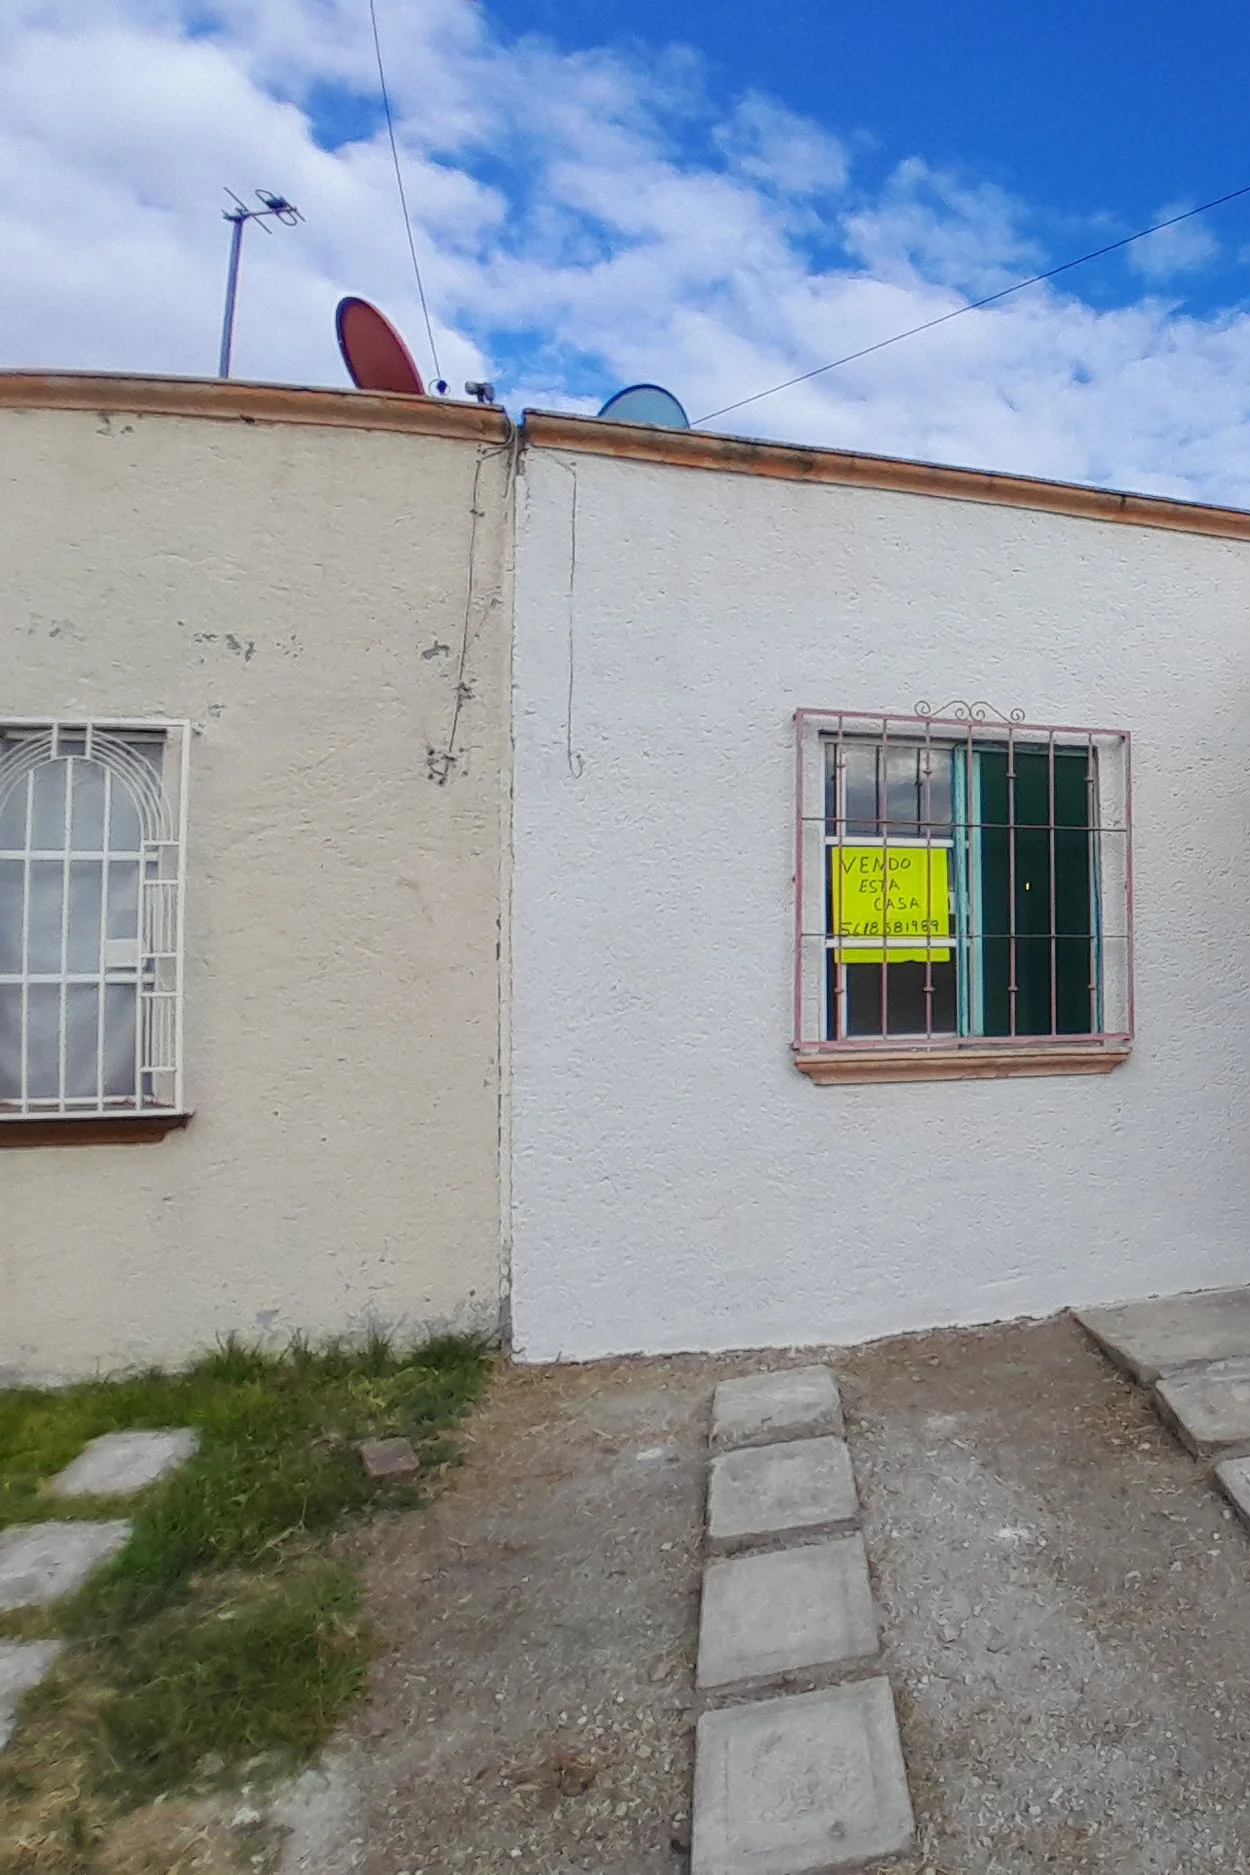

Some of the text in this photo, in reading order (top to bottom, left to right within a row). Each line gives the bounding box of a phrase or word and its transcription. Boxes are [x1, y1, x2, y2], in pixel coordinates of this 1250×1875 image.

[840, 856, 911, 874] VENDO
[858, 878, 900, 893] ESTA
[874, 897, 919, 911] CASA
